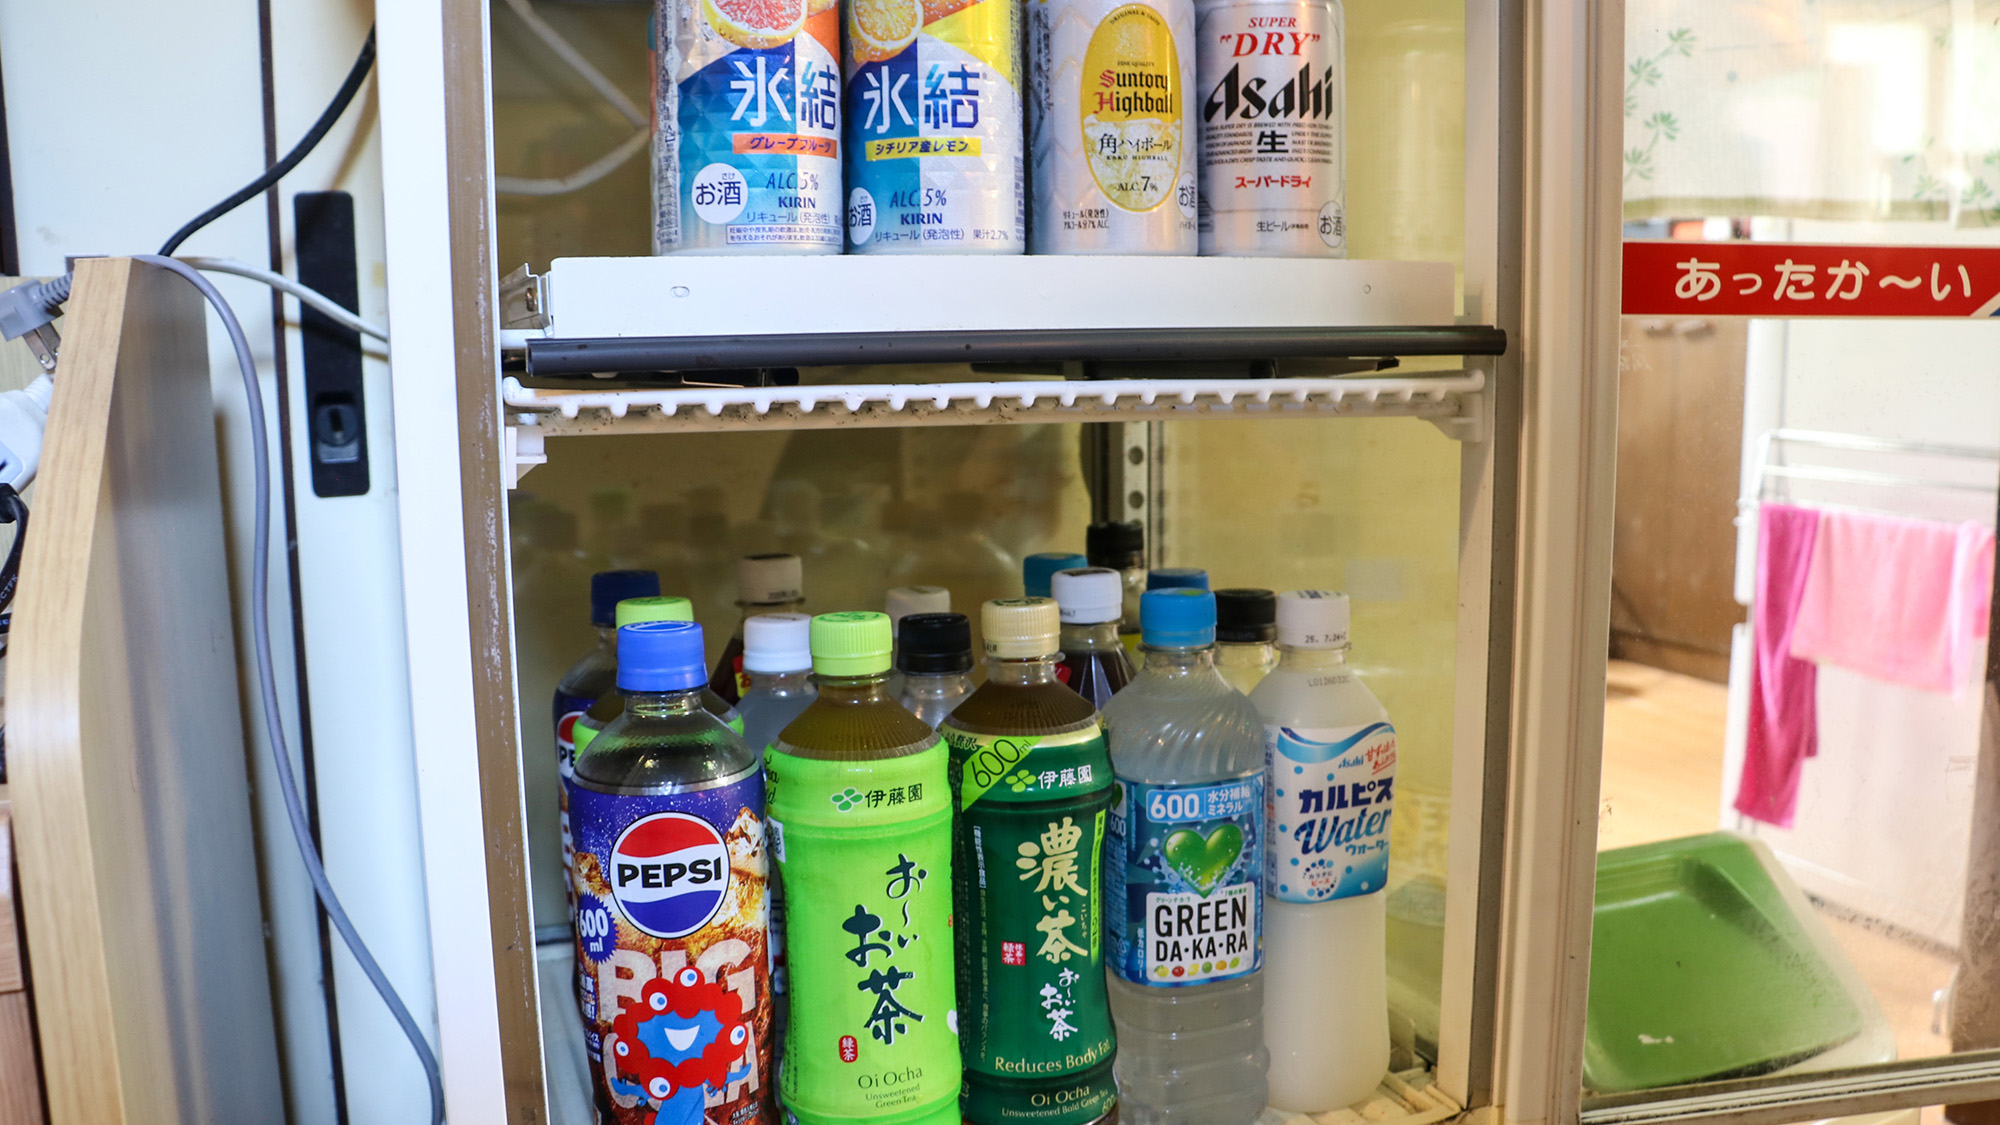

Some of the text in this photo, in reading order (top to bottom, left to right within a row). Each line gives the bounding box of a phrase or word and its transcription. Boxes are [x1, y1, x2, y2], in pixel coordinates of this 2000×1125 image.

[1248, 16, 1297, 28] SUPER
[1099, 69, 1168, 93] Suntory
[1204, 62, 1333, 123] Asahi
[730, 57, 836, 131] 氷結
[863, 64, 981, 134] 氷結
[1093, 91, 1173, 118] Highball
[750, 136, 832, 153] グレープフルーツ
[875, 140, 969, 156] シチリア産レモン
[1099, 133, 1172, 154] 角ハイボール
[1256, 130, 1289, 154] 生
[696, 181, 742, 206] お酒
[1235, 175, 1311, 189] スーパードライ
[778, 196, 816, 209] KIRIN
[901, 212, 943, 225] KIRIN
[973, 229, 1009, 240] 果汁2.7%
[1675, 258, 1972, 301] あったか～い
[971, 738, 1021, 789] 600
[1338, 754, 1364, 769] Asahi
[1038, 765, 1092, 790] 伊藤園
[865, 783, 923, 808] 伊藤園
[1150, 793, 1200, 819] 600
[1207, 785, 1250, 804] 水分補給
[1299, 777, 1394, 814] カルピス
[1207, 801, 1244, 816] ミネラル
[1110, 815, 1127, 837] 600
[1294, 808, 1392, 856] Water
[617, 856, 722, 889] PEPSI
[1016, 816, 1089, 964] 濃い茶
[579, 908, 609, 938] 600
[1155, 895, 1248, 938] GREEN
[590, 936, 604, 953] ml
[842, 904, 926, 1045] お茶
[842, 1036, 855, 1062] 緑茶
[995, 1056, 1063, 1073] Reduces
[1066, 1047, 1098, 1069] Body
[858, 1066, 923, 1089] Oi Ocha
[865, 1083, 921, 1101] Unsweetened
[875, 1095, 917, 1109] Green Tea
[1031, 1085, 1090, 1107] Oi Ocha
[1001, 1107, 1061, 1118] Unsweetened
[1062, 1100, 1080, 1114] Bold
[1080, 1094, 1100, 1109] Green
